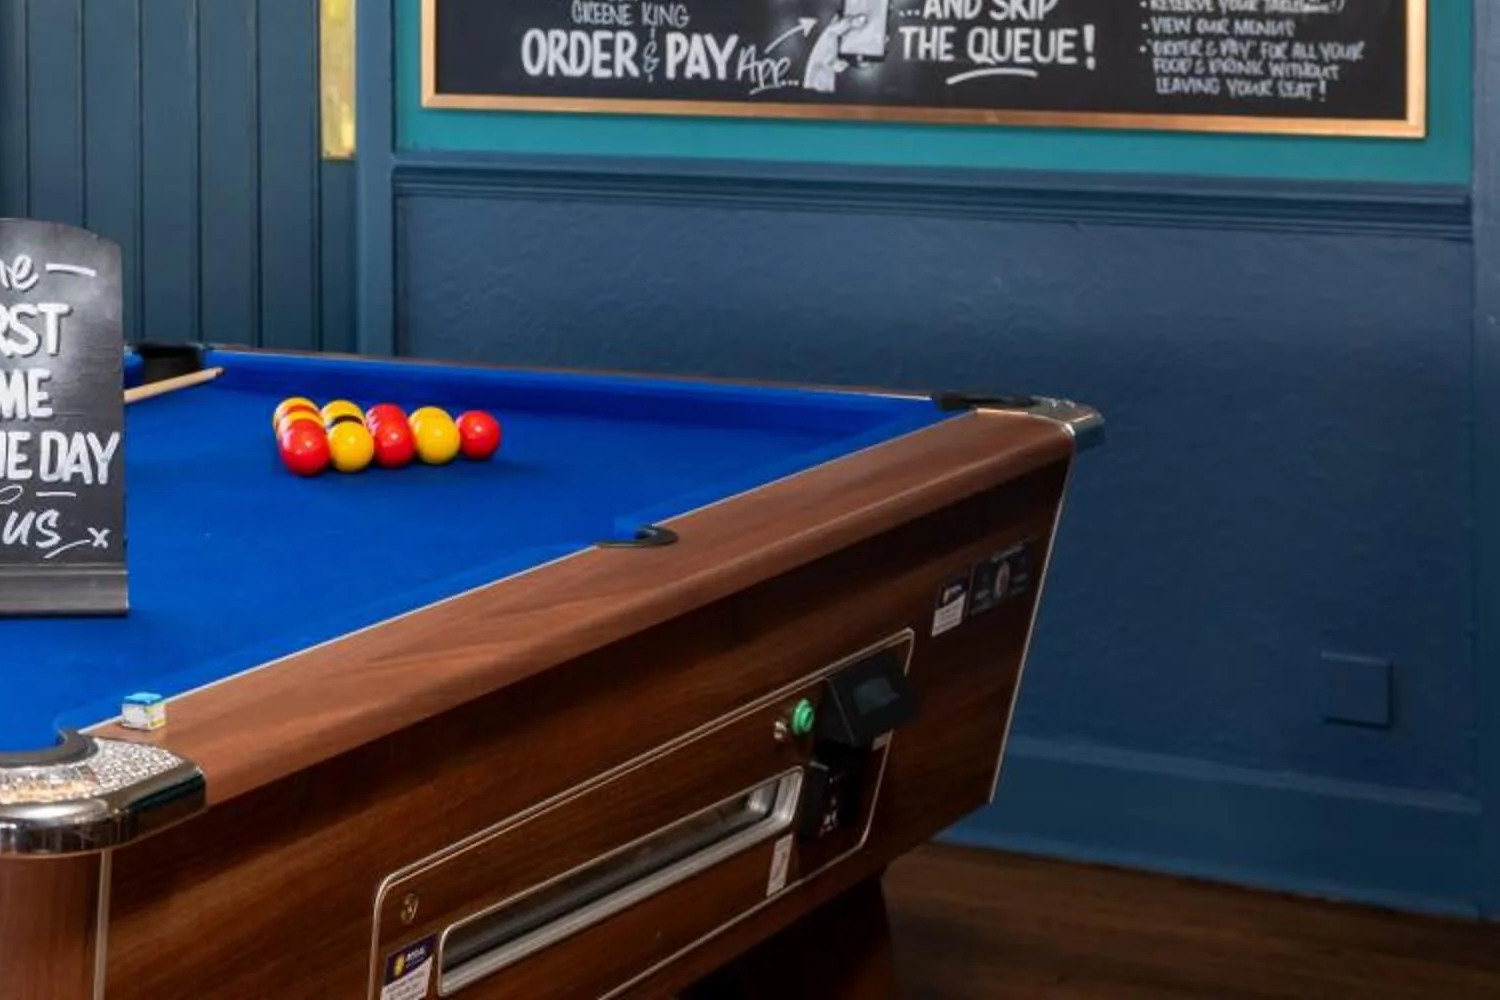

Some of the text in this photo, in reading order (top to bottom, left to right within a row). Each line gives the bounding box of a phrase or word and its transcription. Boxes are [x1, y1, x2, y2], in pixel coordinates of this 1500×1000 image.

[641, 1, 690, 29] KING
[1150, 16, 1296, 37] VIEW OUR MENUS
[521, 28, 640, 78] ORDER
[665, 32, 739, 81] PAY
[898, 24, 1096, 71] THE QUEUE!
[1260, 41, 1288, 60] FOR
[1292, 42, 1316, 59] ALL
[1153, 57, 1191, 75] FOOD
[1209, 57, 1265, 76] DRINK
[1268, 60, 1340, 81] WITHOUT
[1155, 77, 1221, 95] LEAVING
[1225, 78, 1273, 98] YOUR
[39, 430, 120, 485] DAY
[2, 510, 62, 549] US
